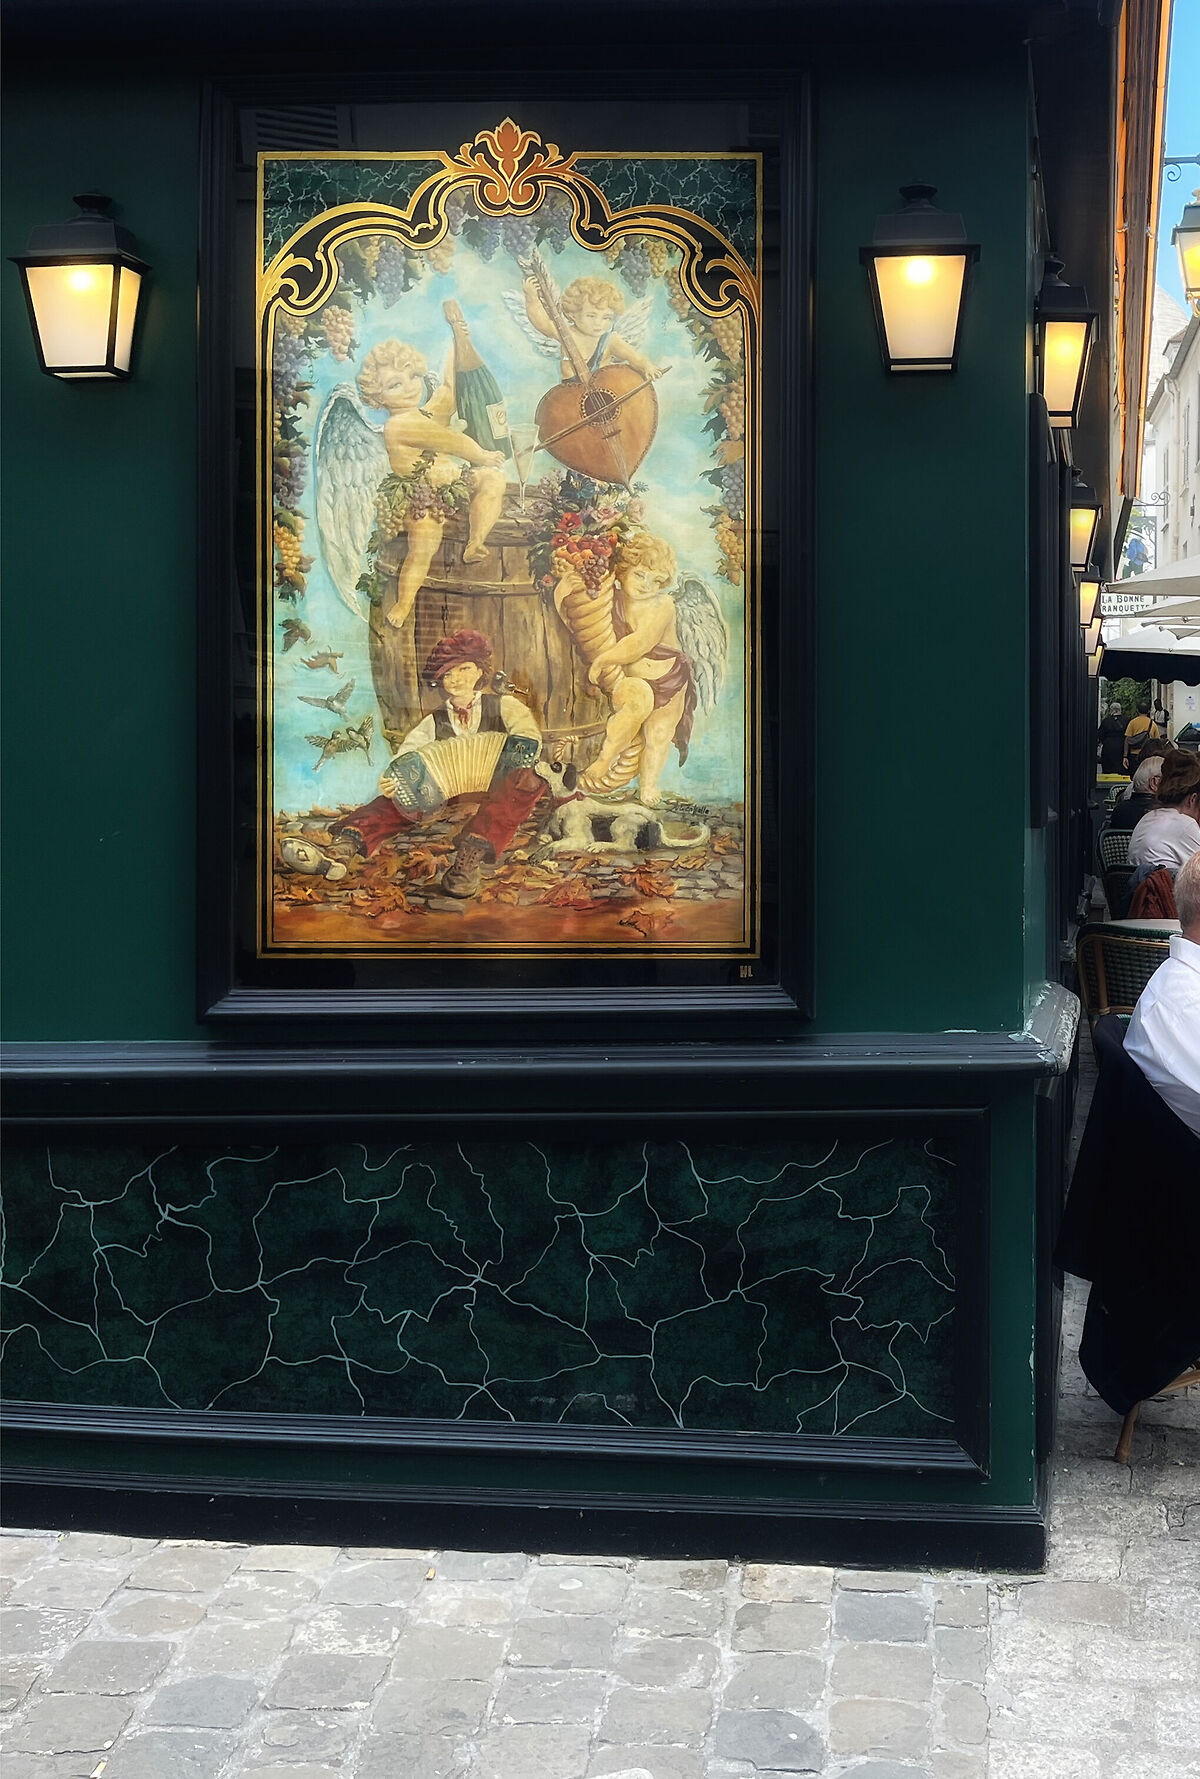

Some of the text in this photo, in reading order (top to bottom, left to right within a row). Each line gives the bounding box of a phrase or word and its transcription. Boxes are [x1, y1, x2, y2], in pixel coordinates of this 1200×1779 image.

[1101, 595, 1144, 603] LA BONNE
[1101, 604, 1150, 613] RANQUETT
